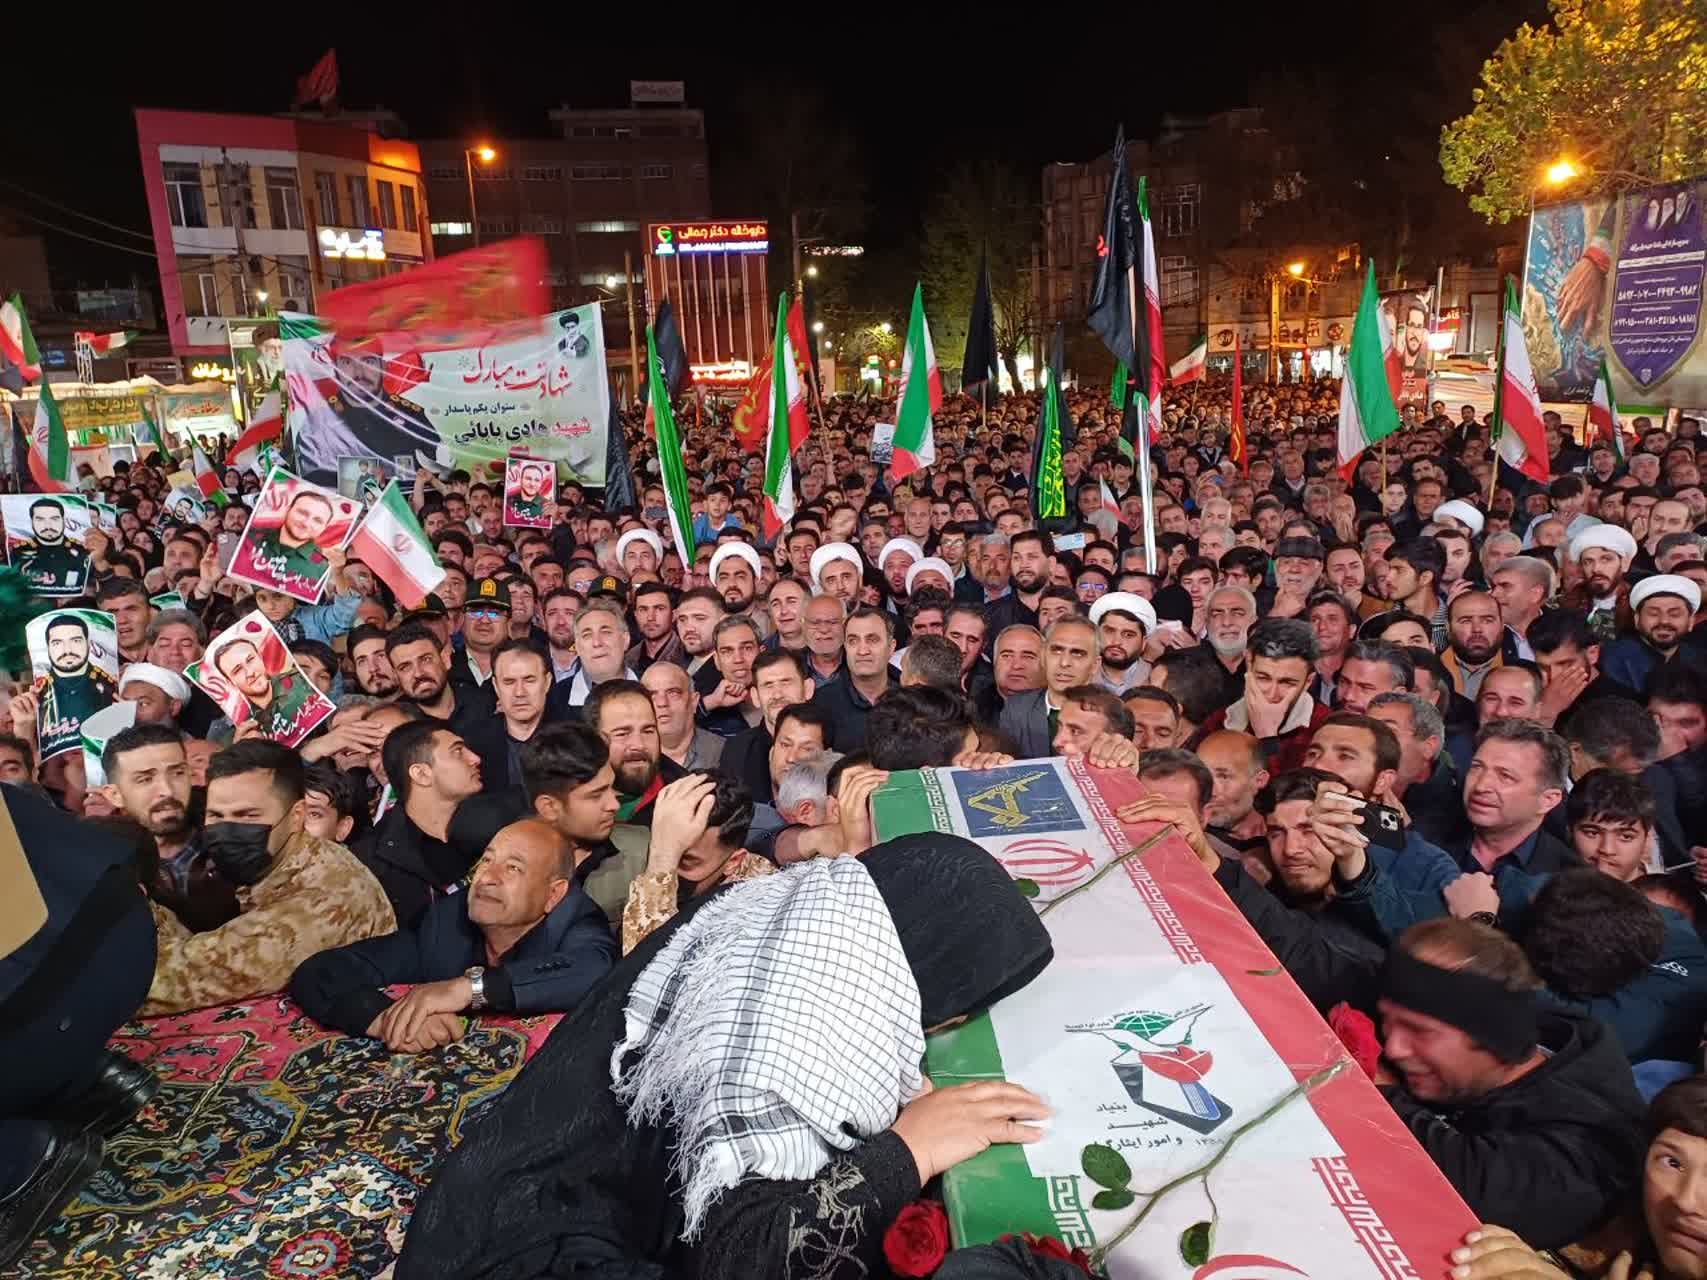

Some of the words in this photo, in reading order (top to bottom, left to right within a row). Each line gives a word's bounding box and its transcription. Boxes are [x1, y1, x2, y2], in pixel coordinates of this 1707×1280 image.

[678, 227, 708, 239] جمالی
[709, 225, 729, 239] دکتر
[731, 224, 766, 237] داروخانه
[444, 404, 471, 416] پاسدار
[472, 403, 488, 415] یکم
[490, 402, 516, 414] ستوان
[506, 420, 547, 441] هادی
[1096, 1102, 1128, 1113] بنیاد
[1107, 1117, 1168, 1130] شهید
[1148, 1134, 1172, 1147] امور
[1175, 1135, 1183, 1145] و
